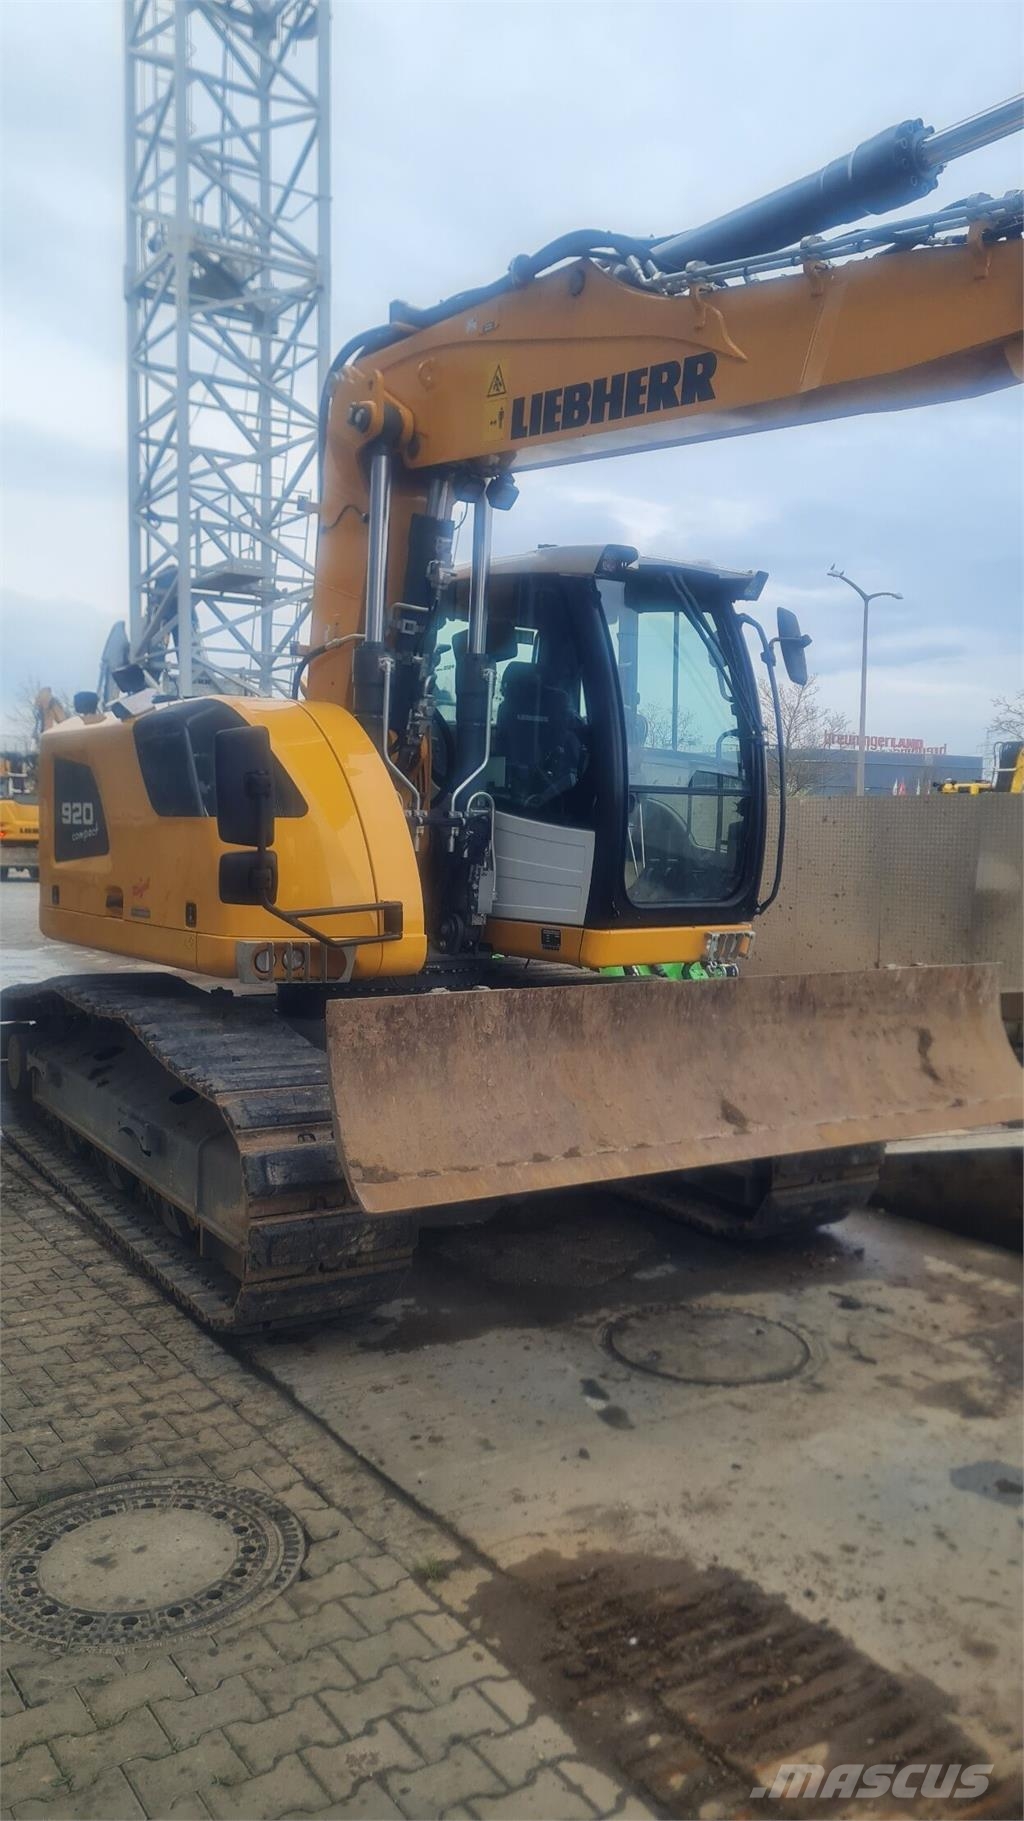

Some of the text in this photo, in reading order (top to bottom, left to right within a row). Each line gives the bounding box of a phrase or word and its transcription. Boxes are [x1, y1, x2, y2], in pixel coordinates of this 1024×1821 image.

[510, 352, 718, 440] LIEBHERR
[62, 802, 94, 825] 920
[72, 821, 98, 842] compact
